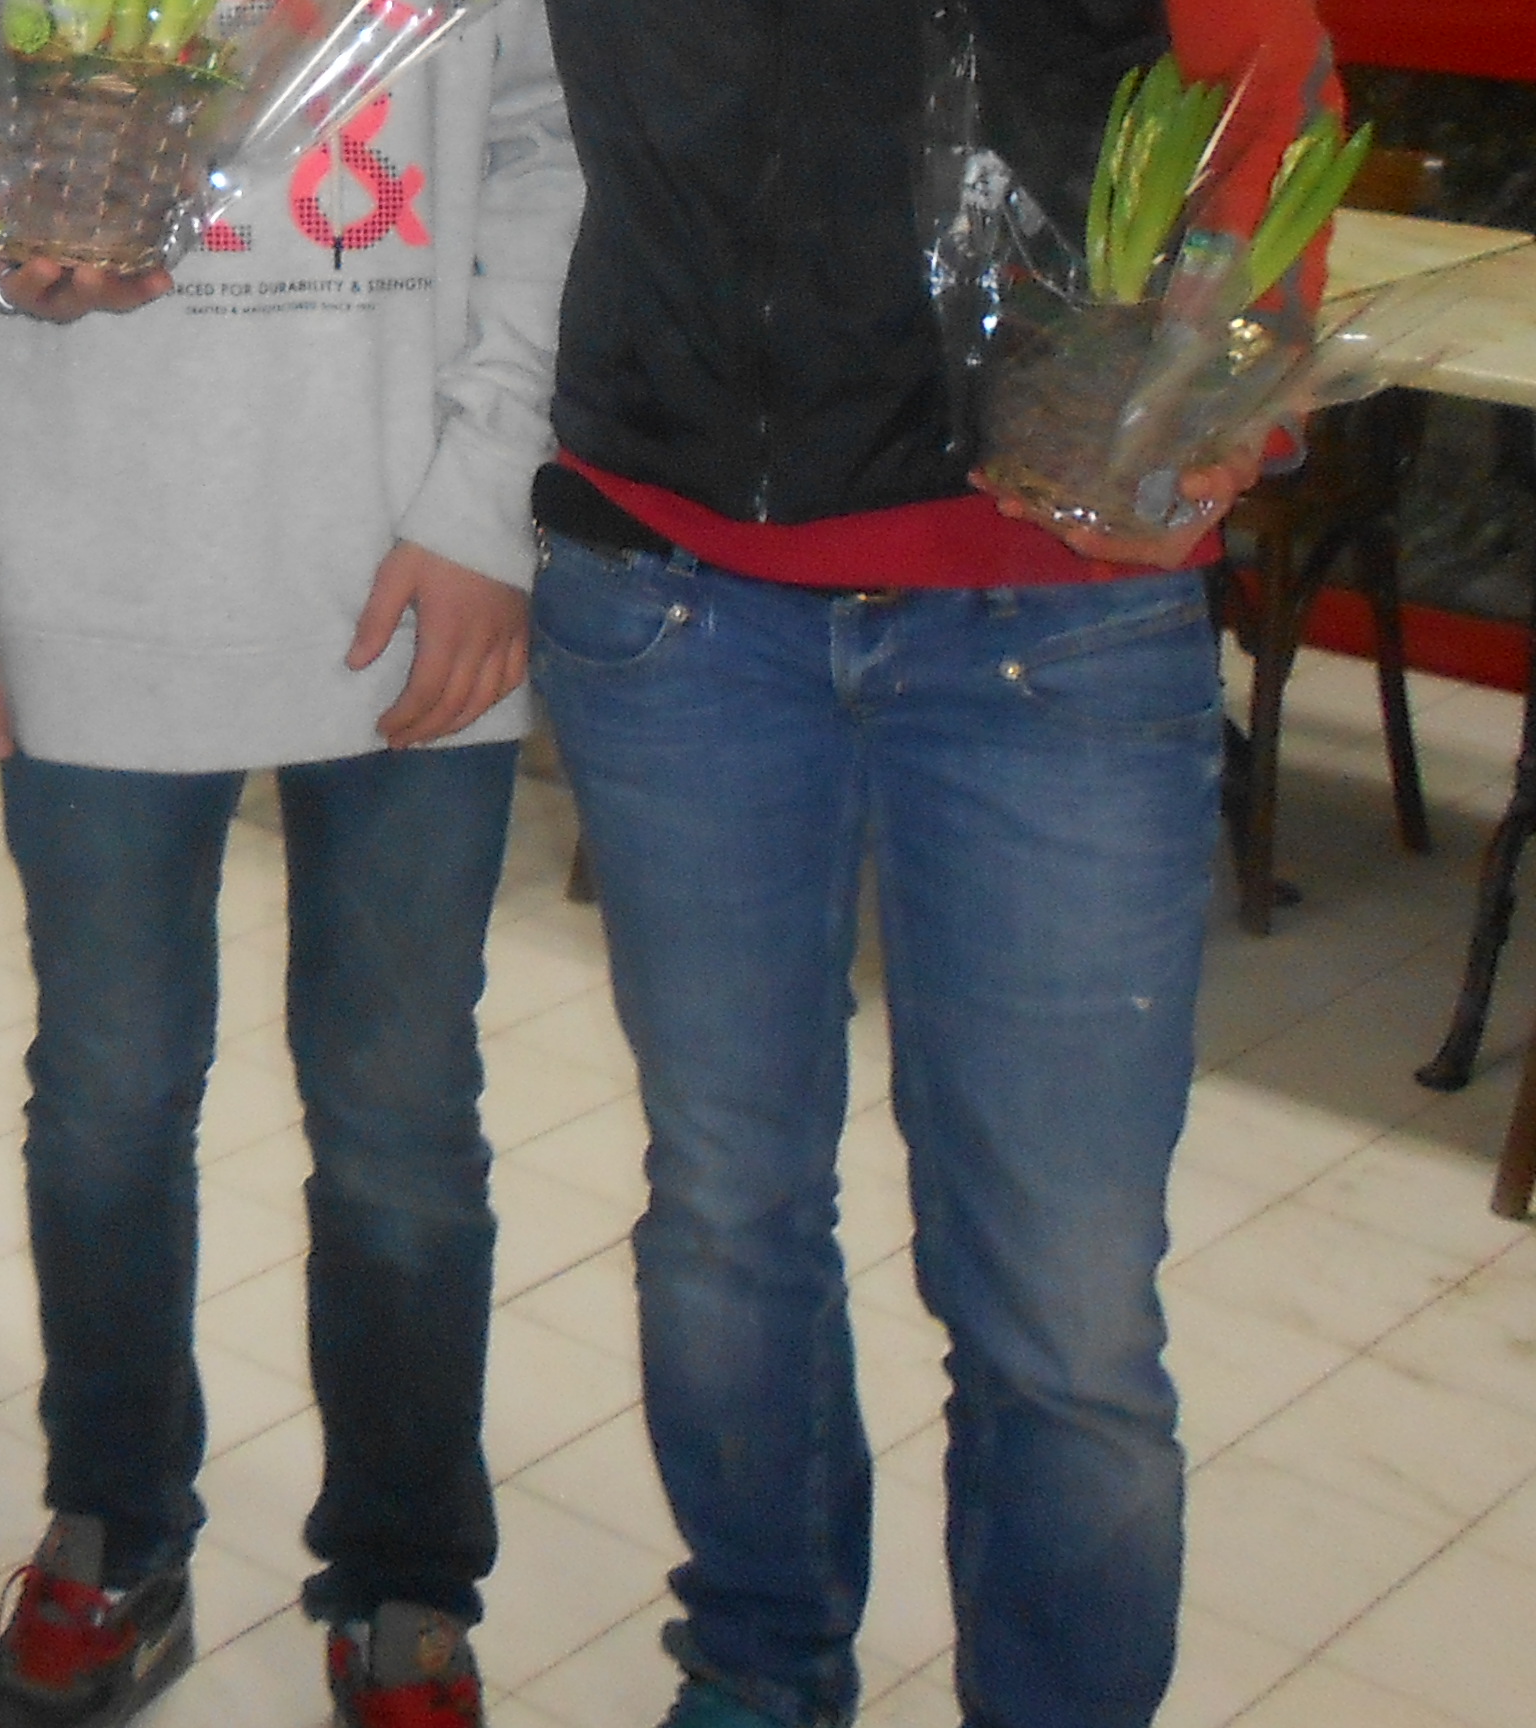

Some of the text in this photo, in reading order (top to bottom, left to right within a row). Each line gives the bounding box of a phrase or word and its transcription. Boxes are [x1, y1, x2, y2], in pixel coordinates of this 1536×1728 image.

[258, 278, 343, 295] DURABILITY
[350, 280, 361, 294] &
[367, 276, 435, 293] STRENGTH
